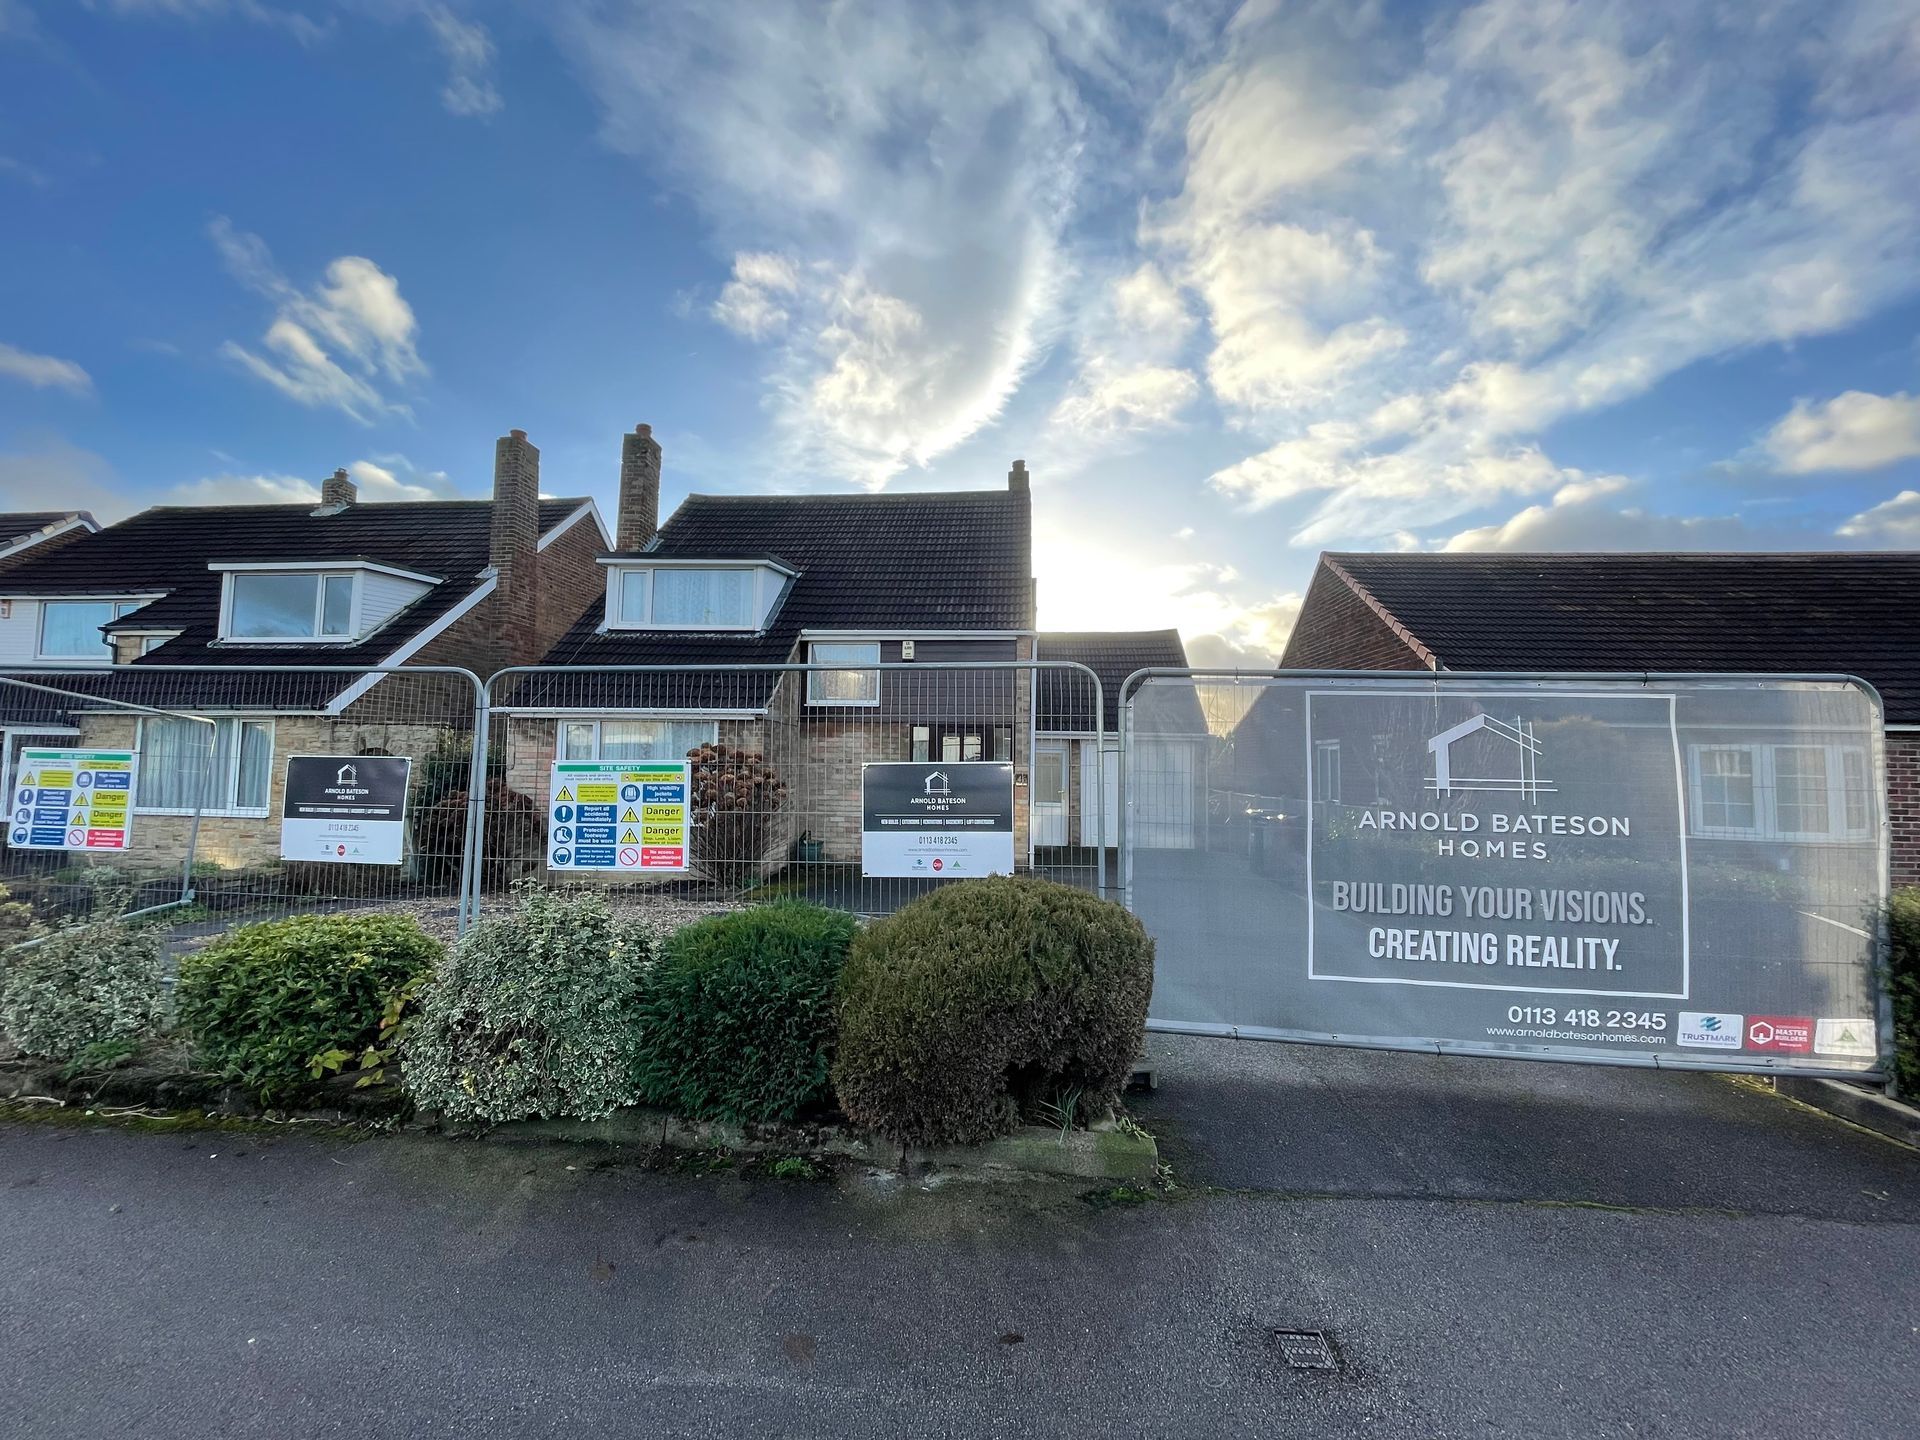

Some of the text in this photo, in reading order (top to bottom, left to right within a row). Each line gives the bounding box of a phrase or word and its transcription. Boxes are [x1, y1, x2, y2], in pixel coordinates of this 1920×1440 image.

[96, 793, 125, 801] Danger
[94, 810, 122, 819] Danger
[646, 808, 680, 816] Danger
[646, 827, 679, 836] Danger
[1358, 810, 1630, 836] ARNOLD BATESON
[1438, 840, 1548, 860] HOMES
[1332, 880, 1654, 925] BUILDING YOUR VISIONS.
[1368, 927, 1622, 971] CREATING REALITY.
[1508, 1006, 1667, 1030] 0113 418 2345
[1486, 1026, 1666, 1044] www.arnoldbatesonhomes.com
[1682, 1033, 1737, 1042] TRUSTMARK
